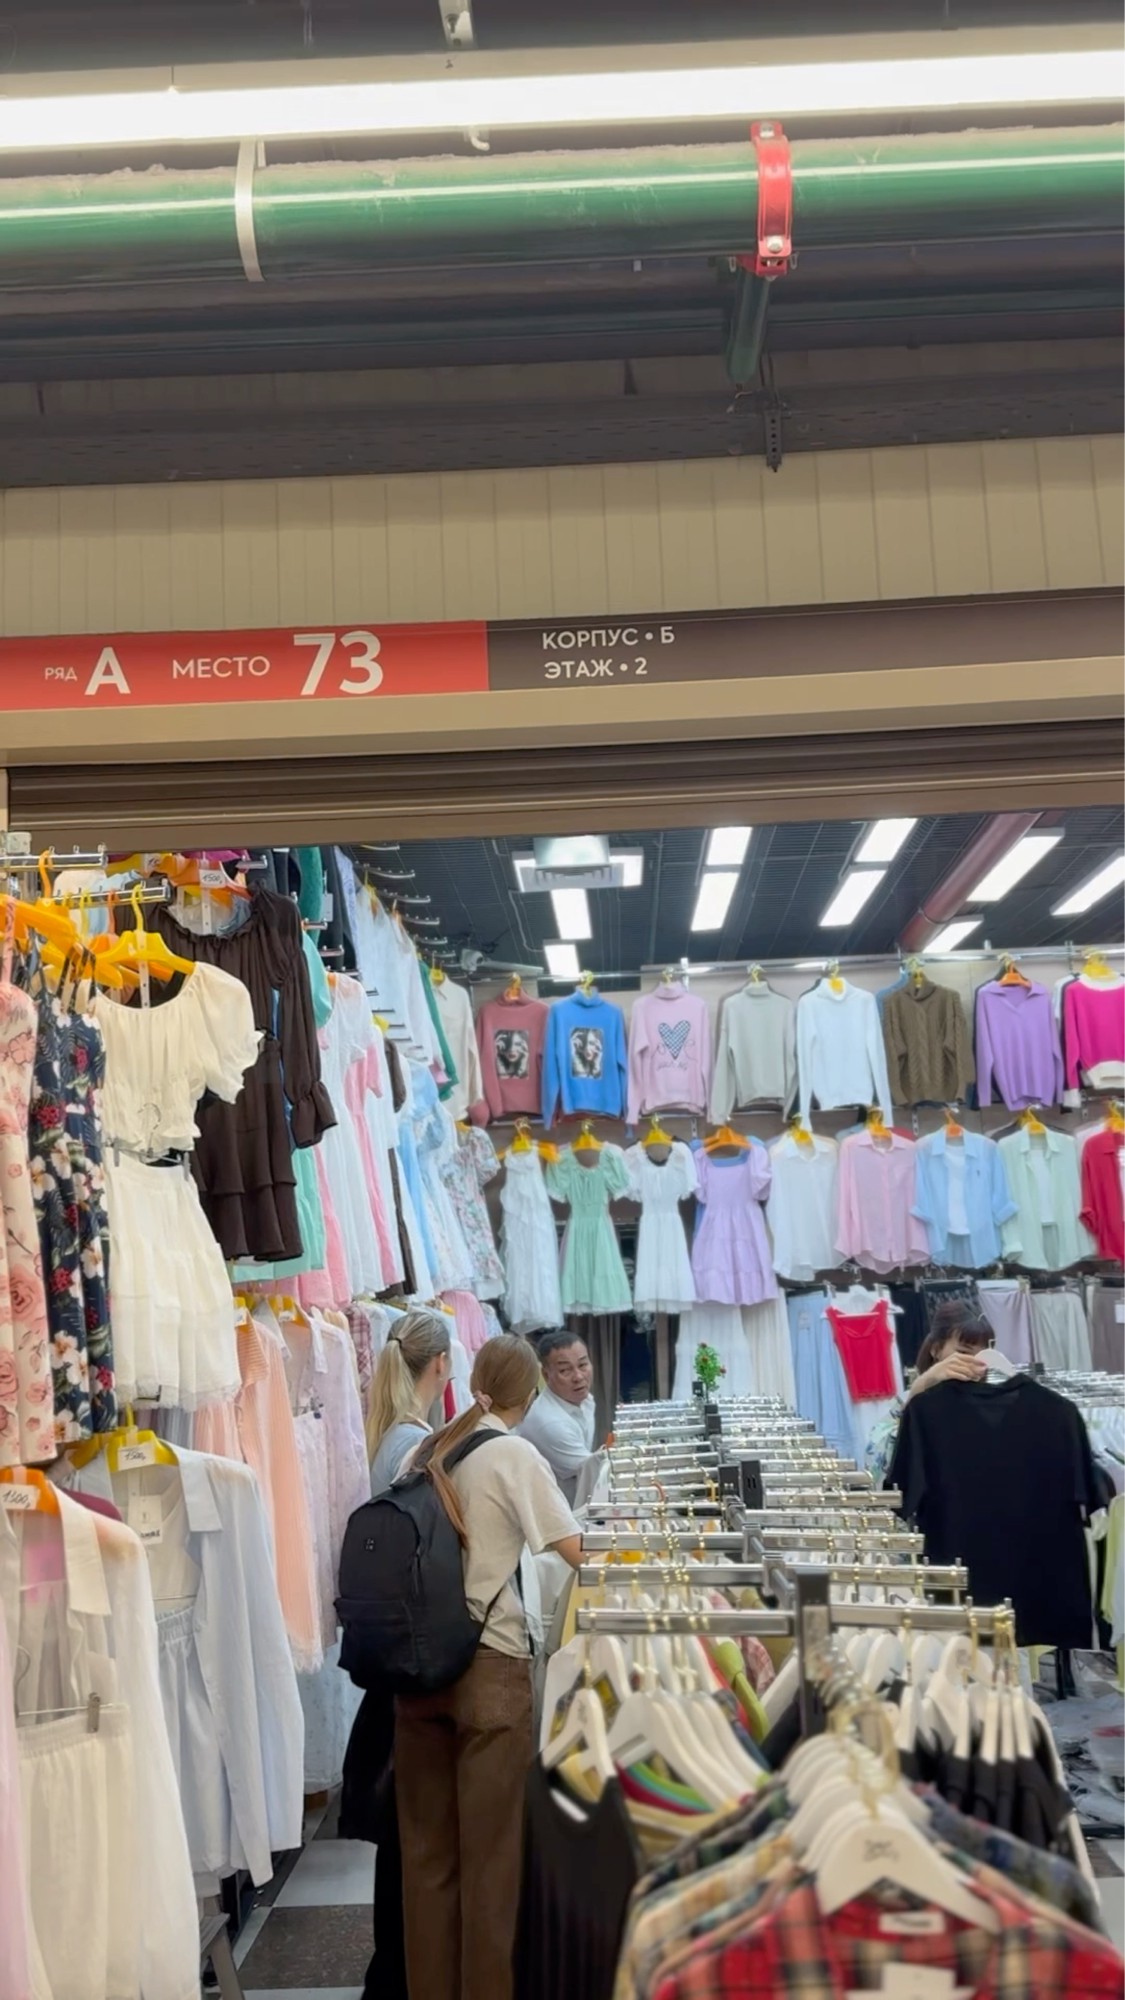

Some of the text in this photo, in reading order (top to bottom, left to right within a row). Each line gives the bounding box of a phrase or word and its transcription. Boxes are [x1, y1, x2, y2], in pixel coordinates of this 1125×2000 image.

[542, 626, 675, 650] КОРПУС Б
[44, 630, 384, 696] РЯД А МЕСТО 73
[544, 657, 648, 679] ЭТАЖ 2
